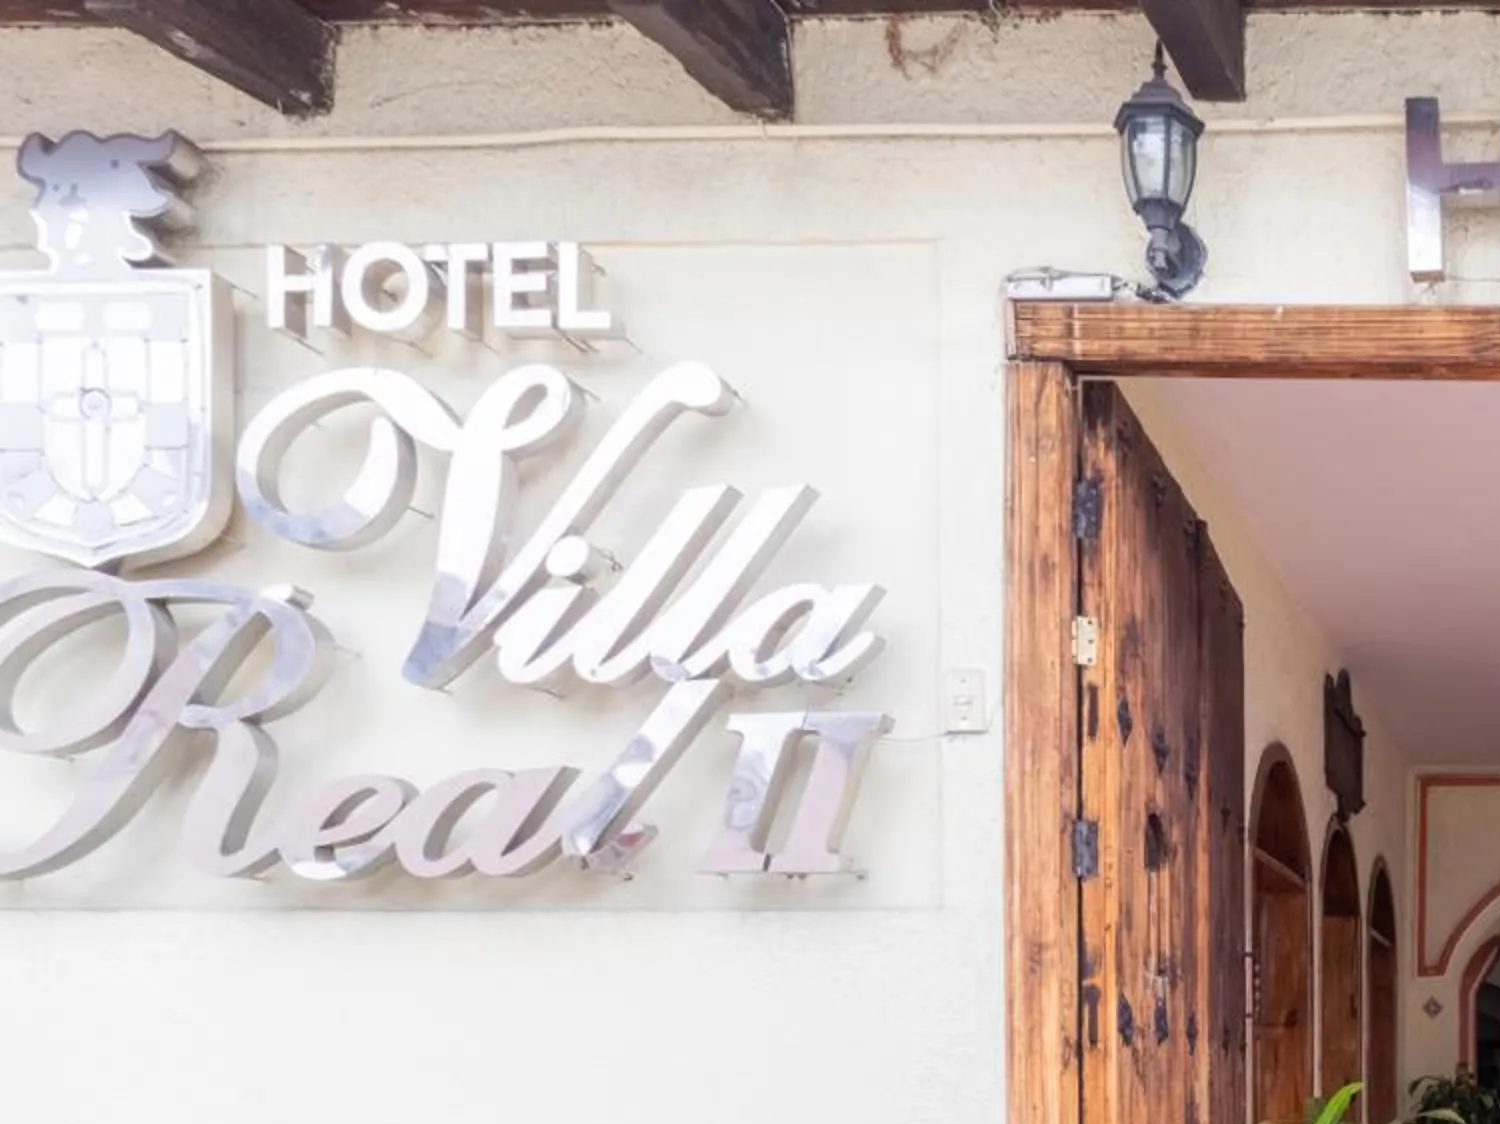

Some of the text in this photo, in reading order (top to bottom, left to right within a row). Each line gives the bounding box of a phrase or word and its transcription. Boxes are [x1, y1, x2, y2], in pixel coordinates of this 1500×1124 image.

[266, 241, 612, 332] HOTEL
[236, 361, 890, 688] Villa
[0, 568, 735, 881] Real
